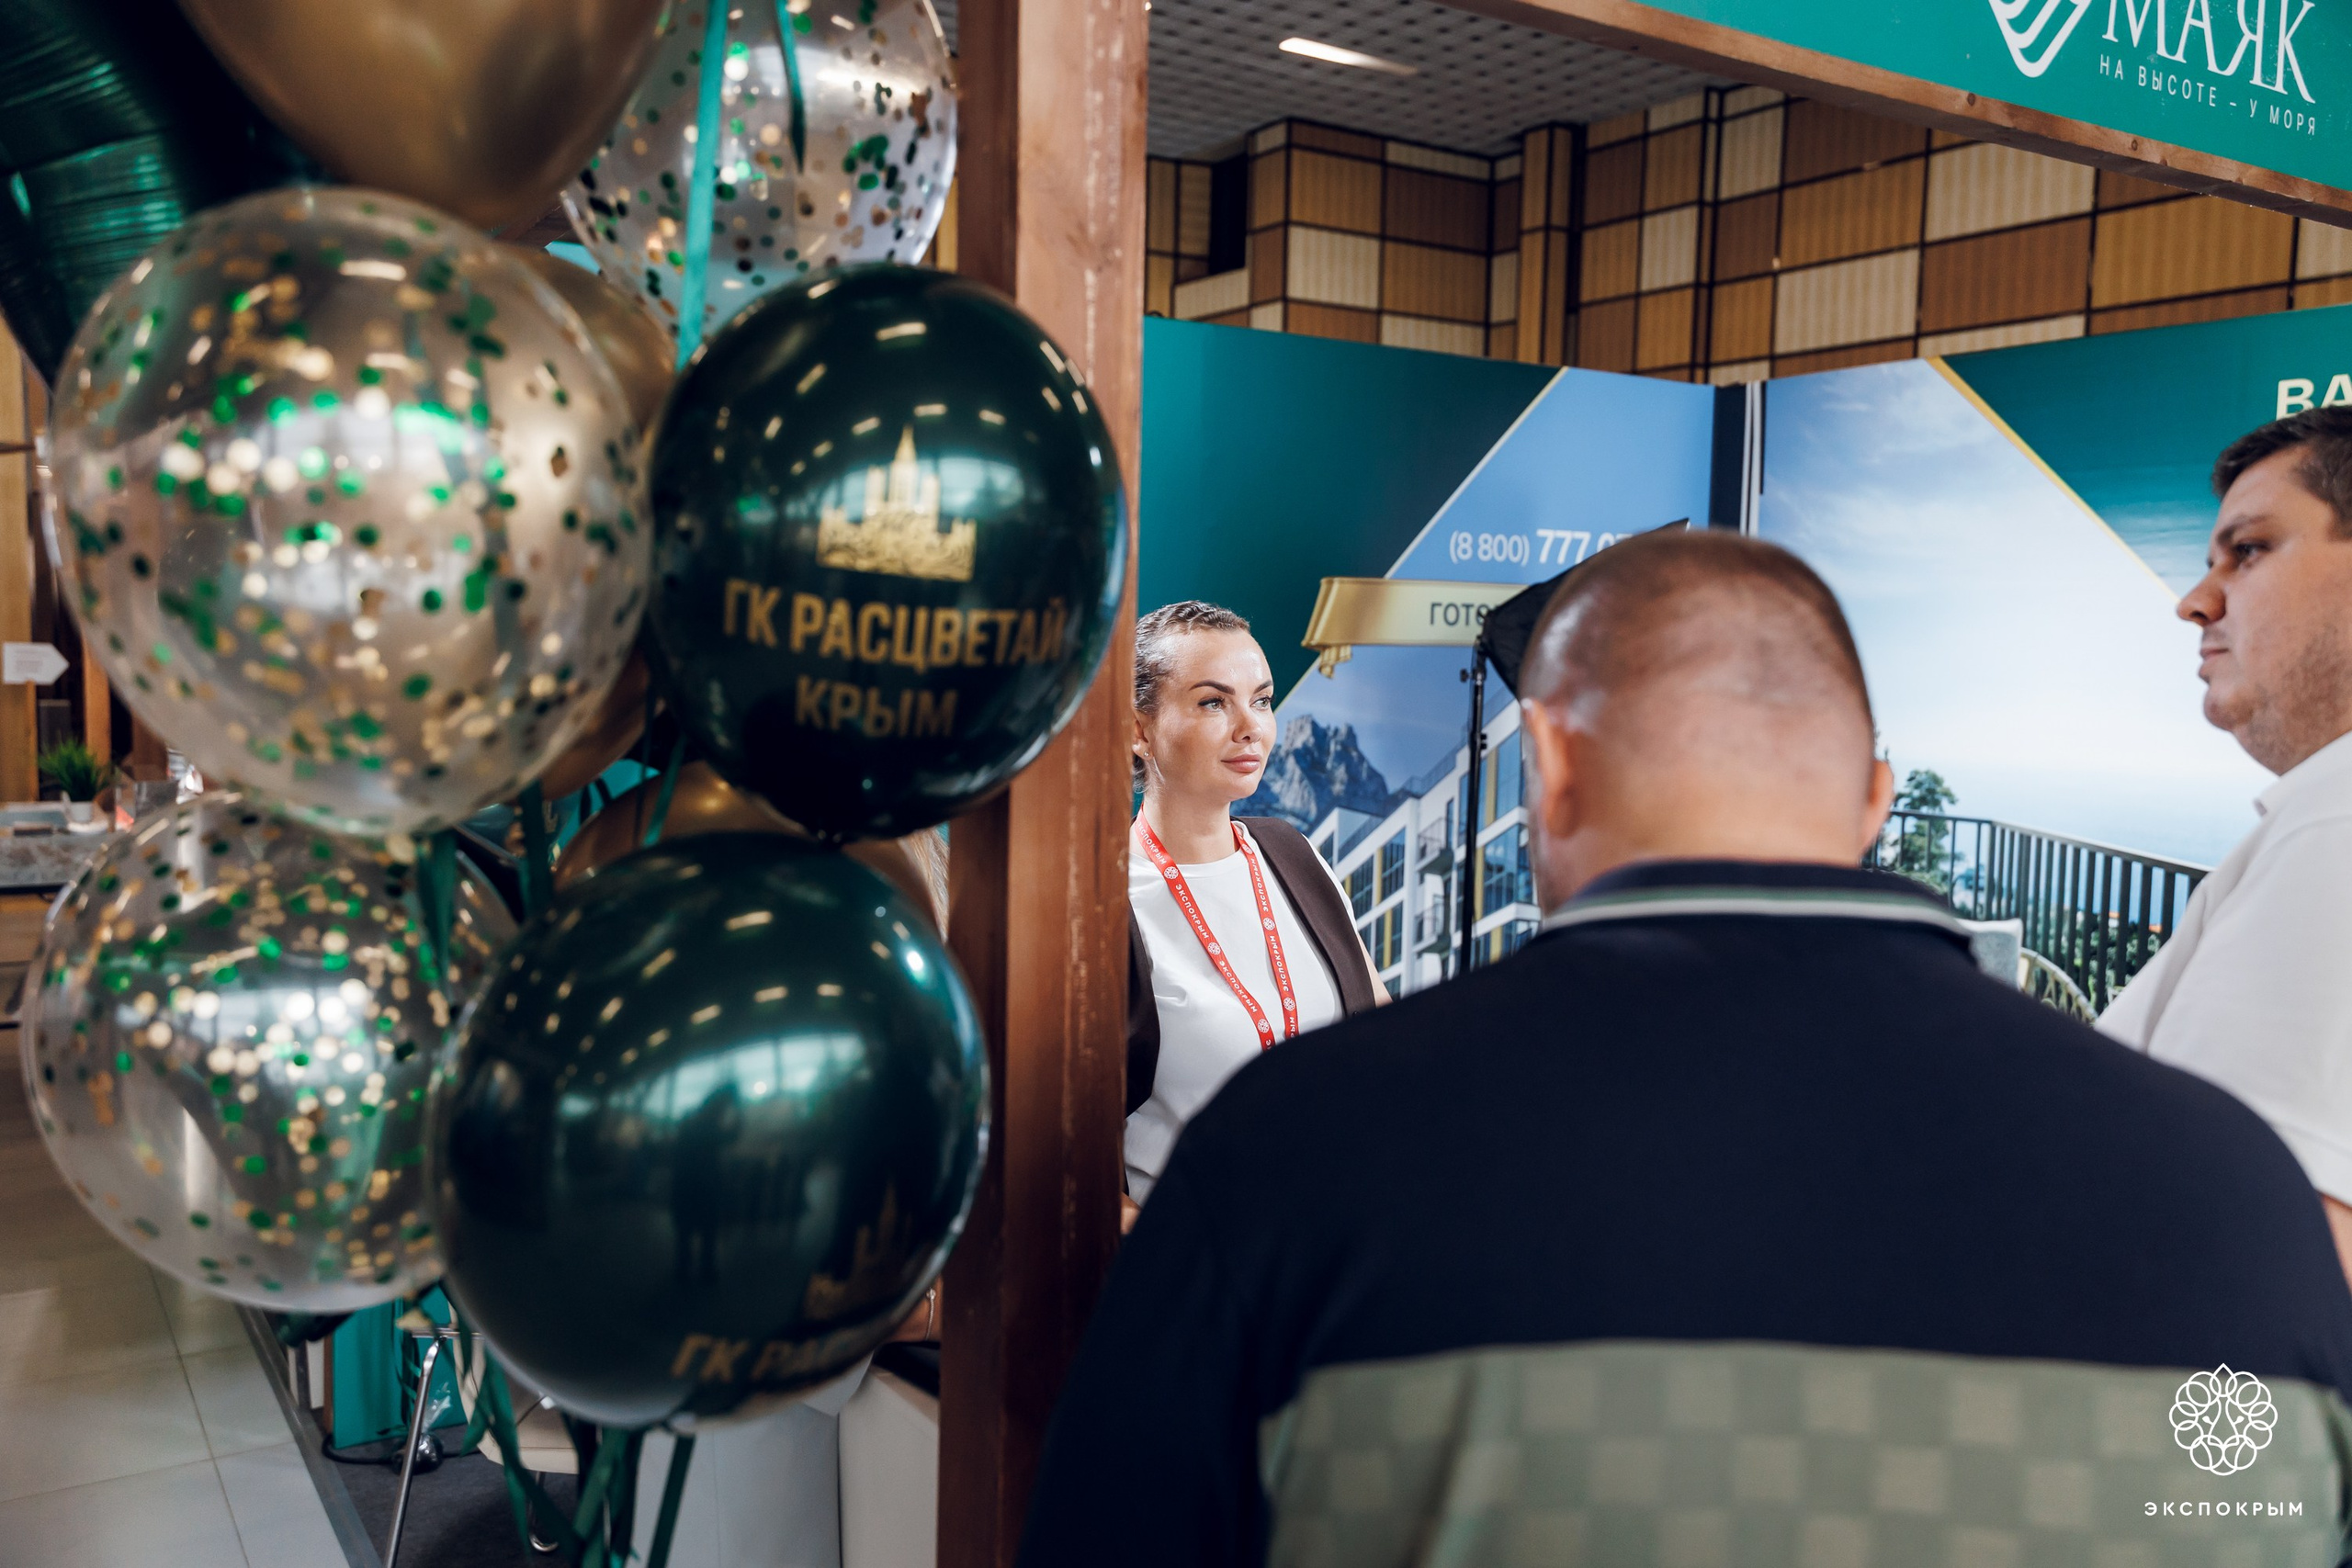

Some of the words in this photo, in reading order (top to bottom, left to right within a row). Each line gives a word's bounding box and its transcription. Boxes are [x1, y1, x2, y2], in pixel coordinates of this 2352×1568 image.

[2100, 54, 2123, 80] НА
[2138, 65, 2217, 107] ВЫСОТЕ
[2249, 98, 2258, 118] У
[2269, 107, 2316, 136] МОРЯ
[1450, 530, 1474, 564] (8
[1477, 533, 1530, 566] 800)
[1536, 528, 1591, 565] 777
[724, 579, 782, 647] ГК
[789, 594, 1068, 673] РАСЦВЕТАЙ
[795, 674, 958, 738] КРЫМ
[1175, 884, 1209, 939] ЭКСПОКРЫМ
[1250, 858, 1269, 912] ЭКСПОКРЫМ
[1219, 960, 1258, 1013] ЭКСПОКРЫМ
[1270, 935, 1289, 992] ЭКСПОКРЫМ
